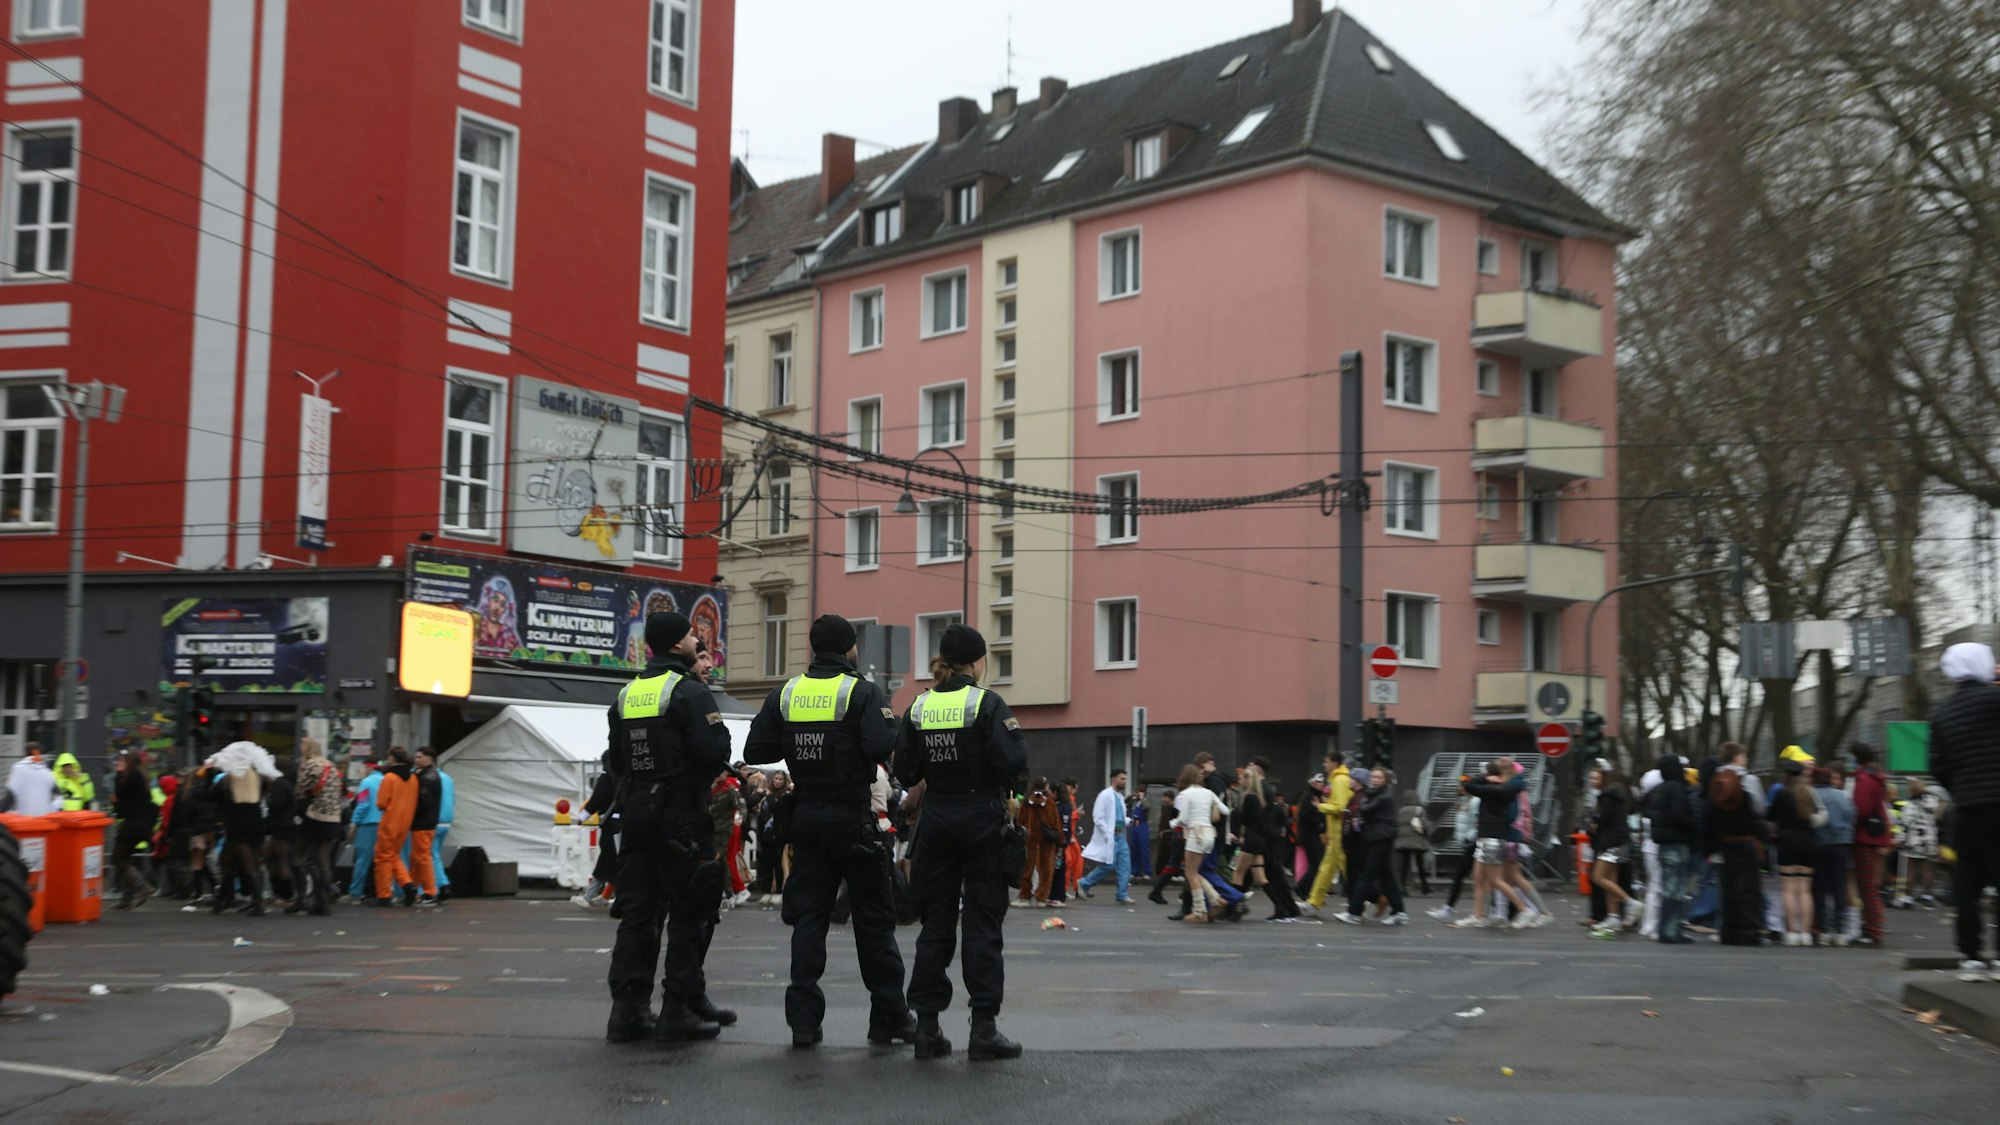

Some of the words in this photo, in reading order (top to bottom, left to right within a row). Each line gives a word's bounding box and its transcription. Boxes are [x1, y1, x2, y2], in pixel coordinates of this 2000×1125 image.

[539, 388, 577, 415] Gaffel
[575, 634, 614, 648] ZURÜCK
[626, 693, 657, 707] POLIZEI
[793, 694, 832, 709] POLIZEI
[922, 708, 963, 724] POLIZEI
[630, 727, 647, 741] NRW
[795, 733, 824, 746] NRW
[925, 733, 956, 748] NRW
[632, 742, 649, 756] 264
[796, 747, 823, 761] 2641
[929, 747, 958, 763] 2641
[632, 757, 654, 770] BeSi
